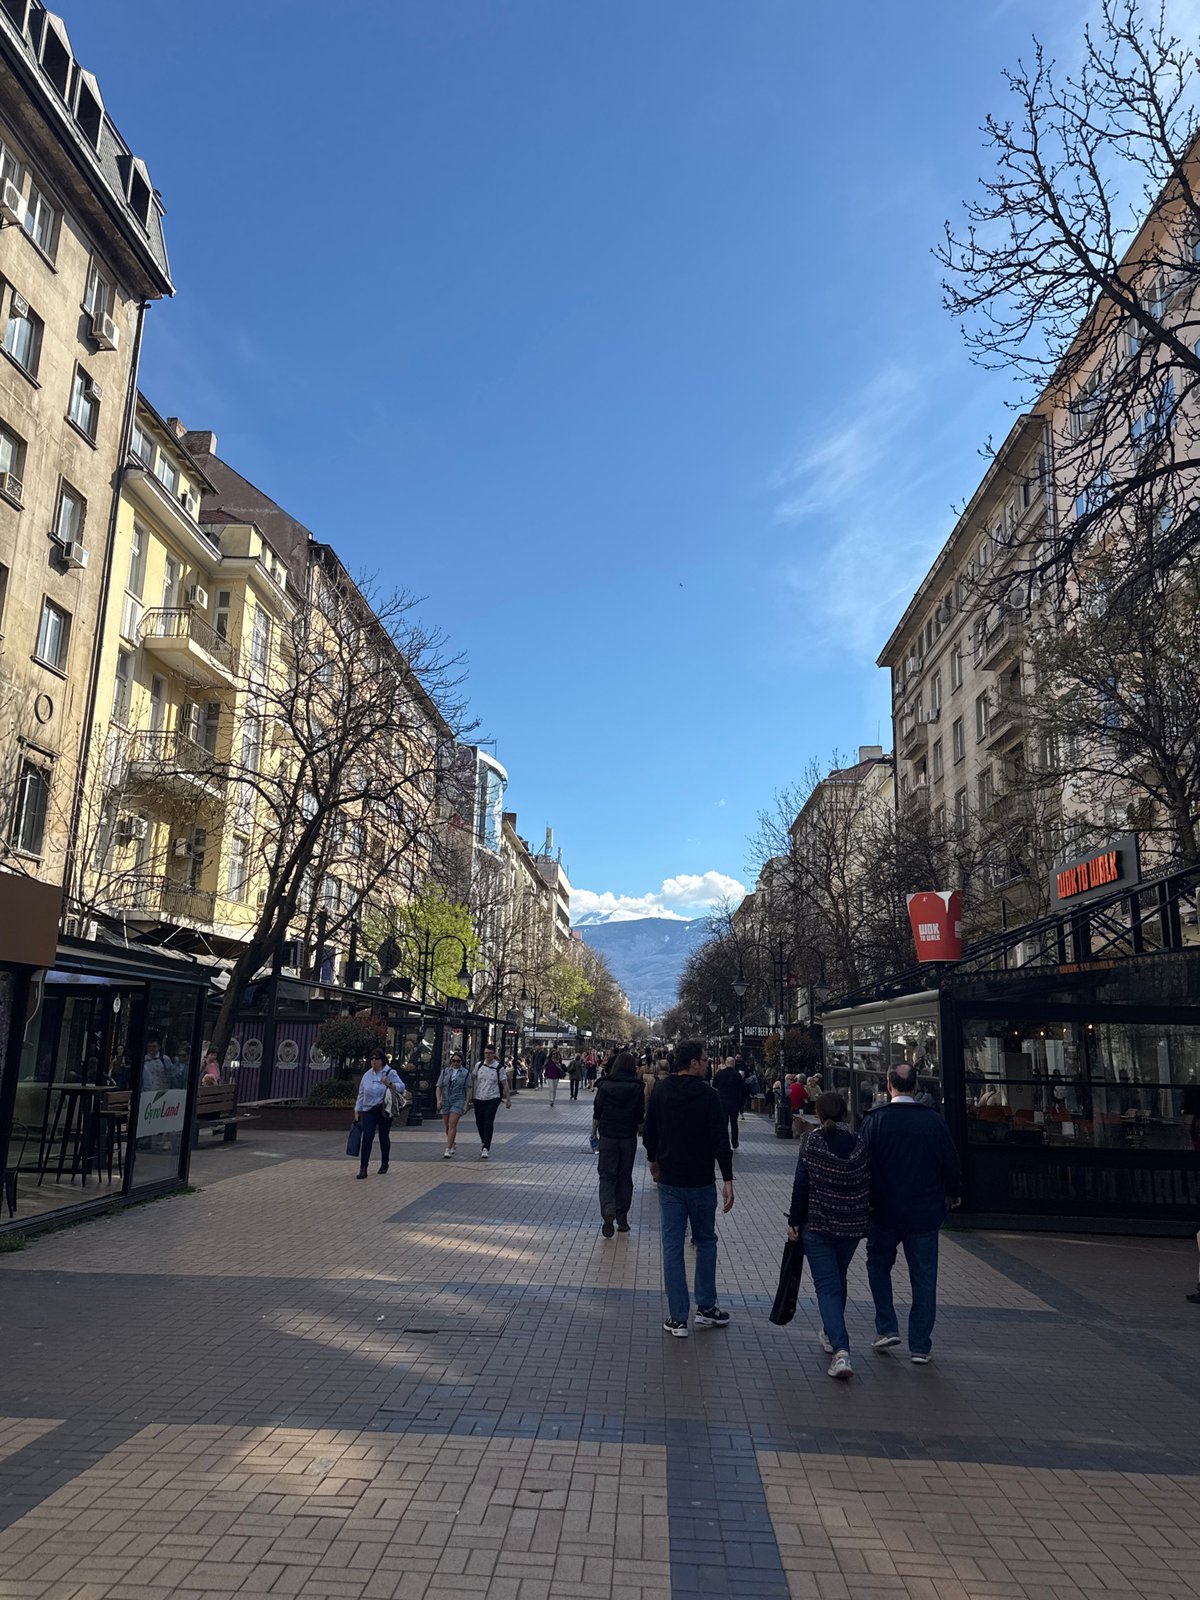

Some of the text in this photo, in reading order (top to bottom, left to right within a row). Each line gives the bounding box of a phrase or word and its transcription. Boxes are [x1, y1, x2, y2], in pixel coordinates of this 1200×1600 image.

[1056, 850, 1118, 900] WOK TO WALK
[918, 923, 940, 935] WOK
[744, 1026, 757, 1036] CRAFT
[758, 1026, 768, 1037] BEER
[144, 1101, 180, 1124] GyroLand
